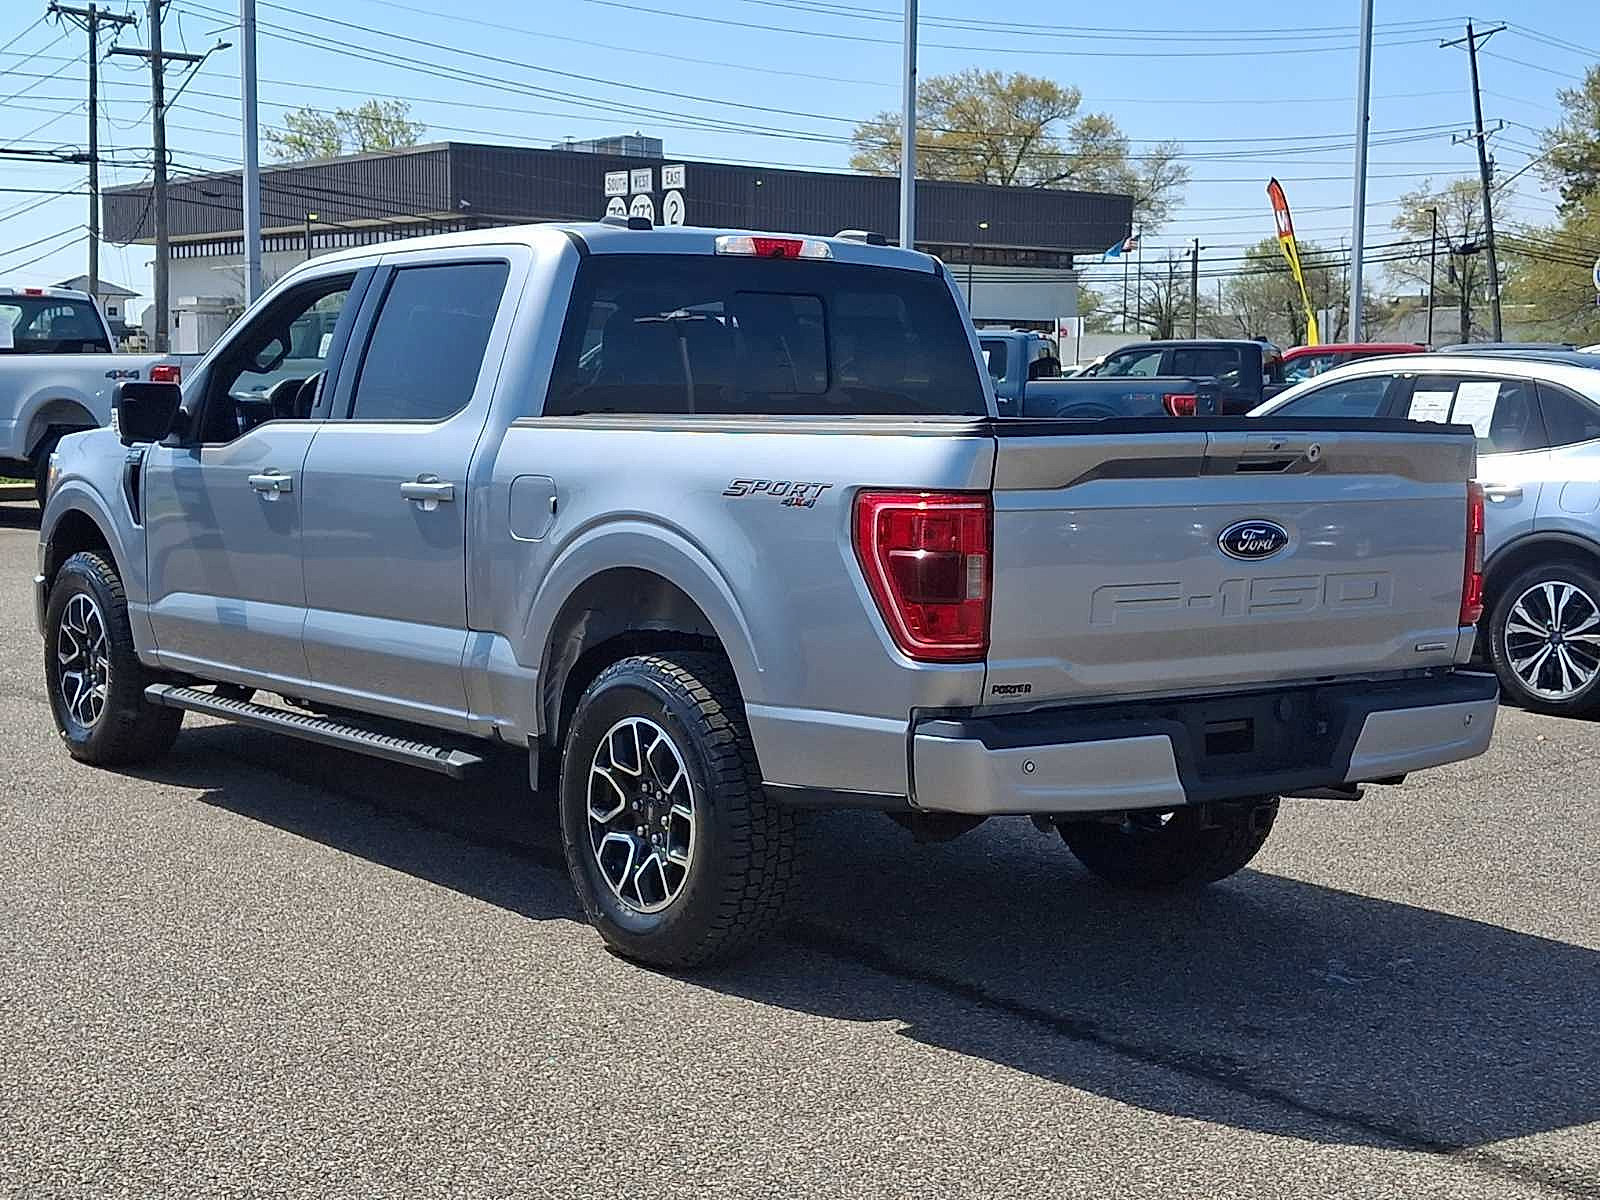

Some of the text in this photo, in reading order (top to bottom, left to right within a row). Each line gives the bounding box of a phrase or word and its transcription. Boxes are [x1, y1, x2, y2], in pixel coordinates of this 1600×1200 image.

[670, 200, 679, 225] 2
[722, 478, 833, 498] SPORT
[1237, 528, 1276, 552] Ford
[1089, 570, 1394, 626] F-150
[991, 683, 1032, 695] PORTER
